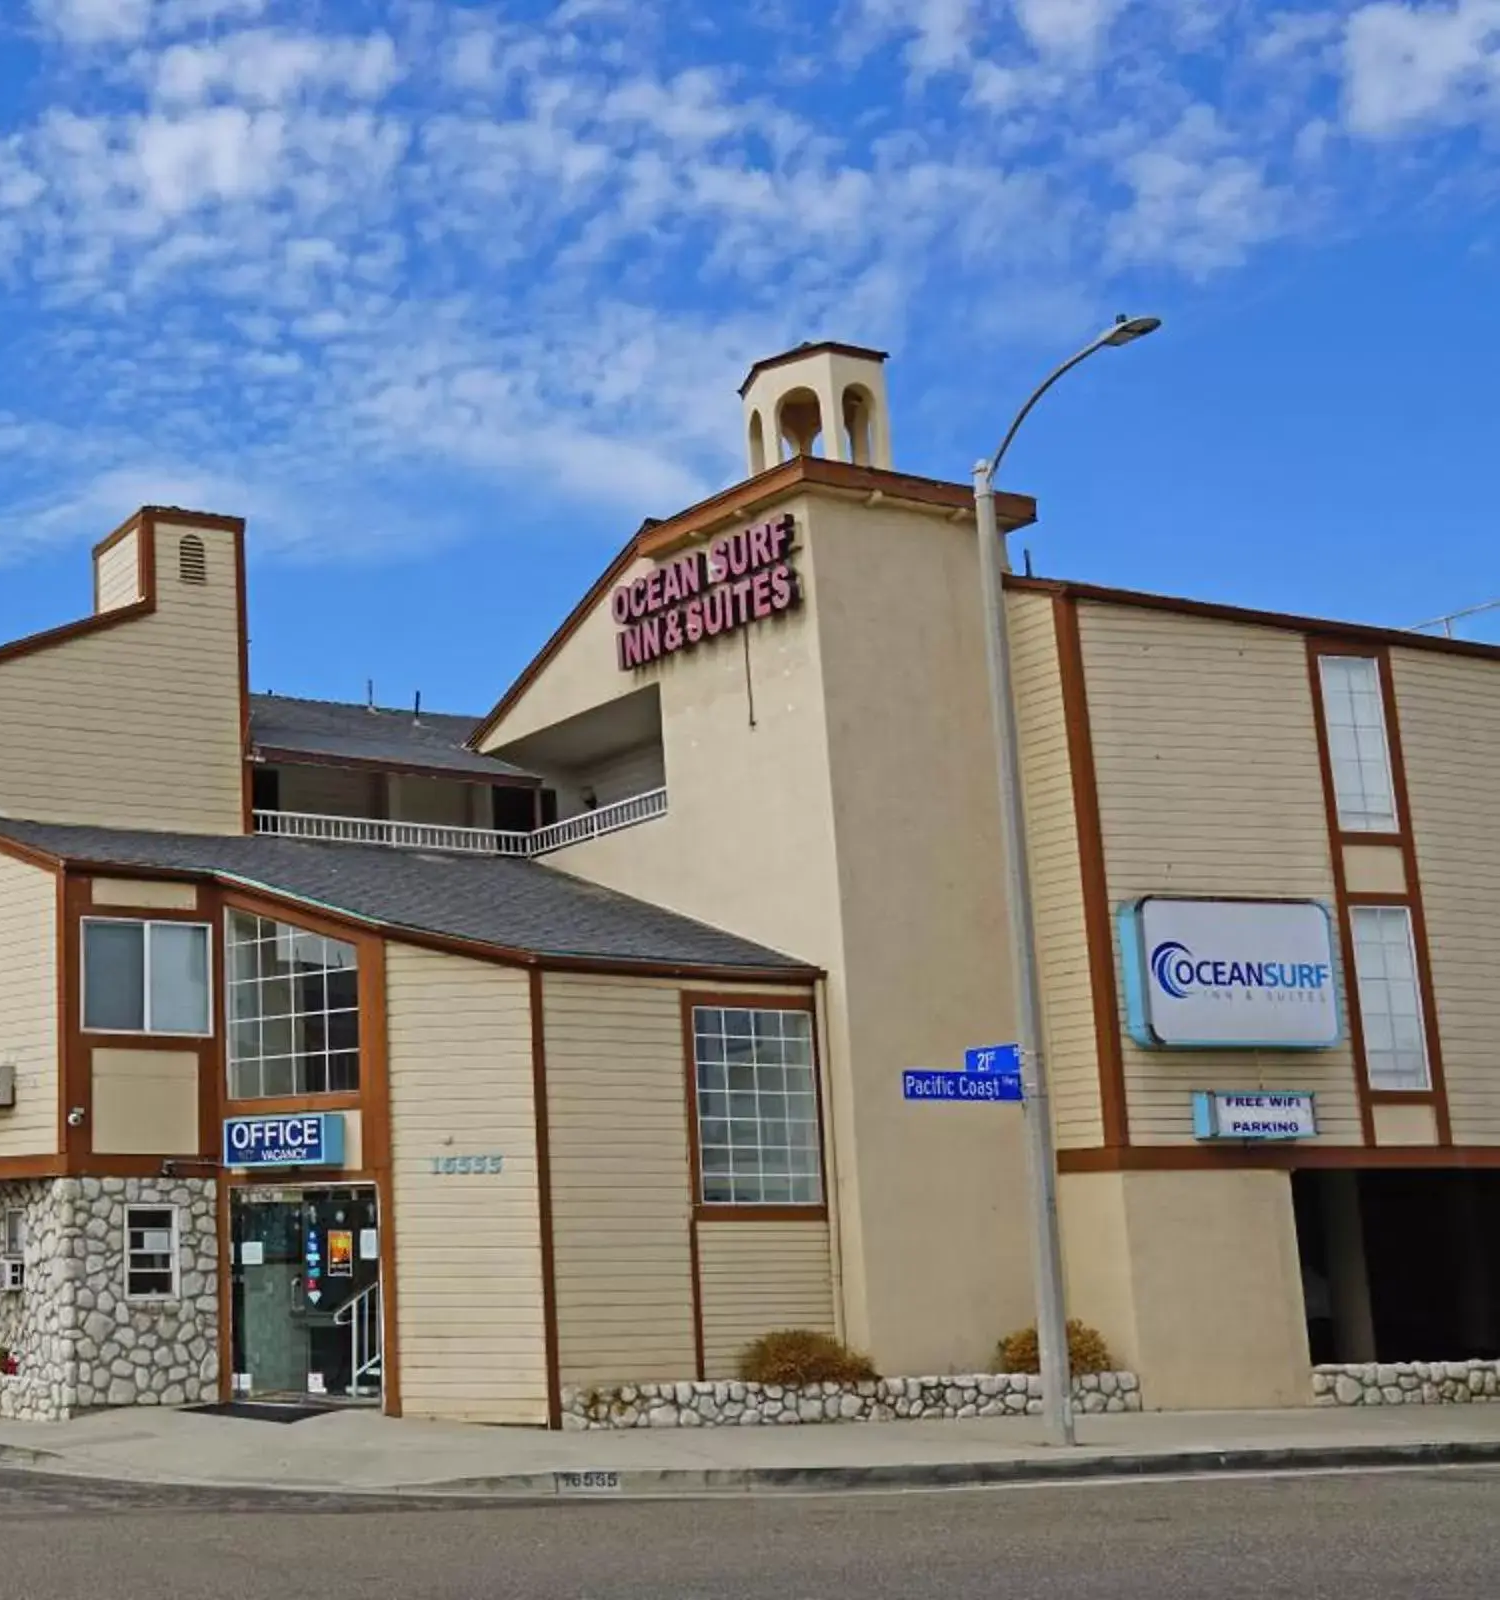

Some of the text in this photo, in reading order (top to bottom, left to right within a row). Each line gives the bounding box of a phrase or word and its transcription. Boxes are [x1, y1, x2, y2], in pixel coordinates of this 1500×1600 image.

[612, 515, 794, 624] OCEAN SURF
[617, 564, 796, 671] INN & SUITES
[905, 1076, 955, 1096] Pacific
[959, 1077, 1000, 1096] Coast
[1226, 1096, 1264, 1107] FREE
[231, 1120, 319, 1149] OFFICE
[1233, 1122, 1299, 1132] PARKING
[261, 1147, 307, 1160] VACANCY
[436, 1155, 504, 1174] 16555
